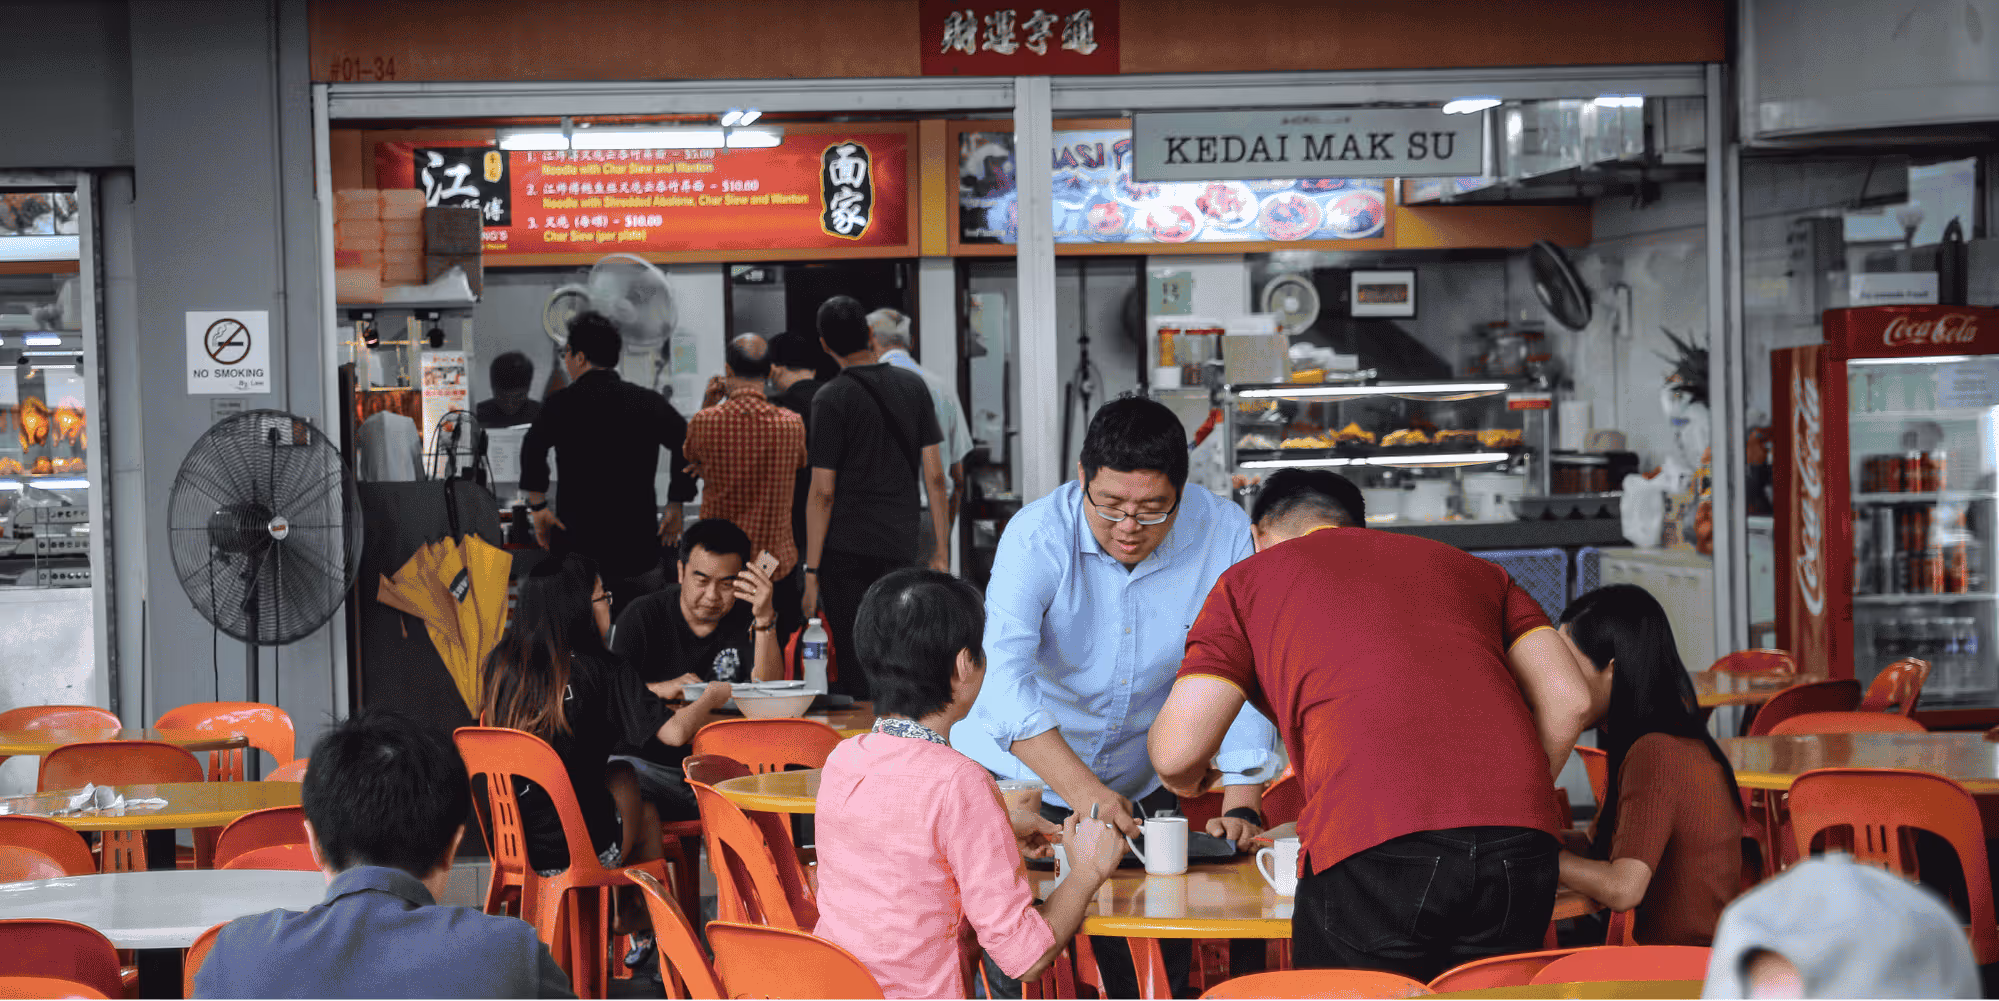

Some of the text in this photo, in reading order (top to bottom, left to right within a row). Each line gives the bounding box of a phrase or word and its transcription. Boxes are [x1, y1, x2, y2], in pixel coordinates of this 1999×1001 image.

[1163, 134, 1289, 164] KEDAI
[1302, 132, 1395, 161] MAK
[1407, 131, 1457, 160] SU
[542, 164, 577, 175] Noodle
[579, 163, 601, 175] with
[602, 162, 627, 175] Char
[629, 162, 653, 174] Siew
[654, 163, 674, 174] and
[421, 151, 480, 207] 江
[829, 144, 868, 234] 面家
[543, 197, 578, 209] Noodle
[580, 196, 602, 208] with
[698, 193, 722, 206] Char
[724, 193, 749, 206] Siew
[750, 194, 770, 205] and
[543, 230, 568, 242] Char
[569, 230, 594, 242] Siew
[193, 368, 264, 378] NO SMOKING
